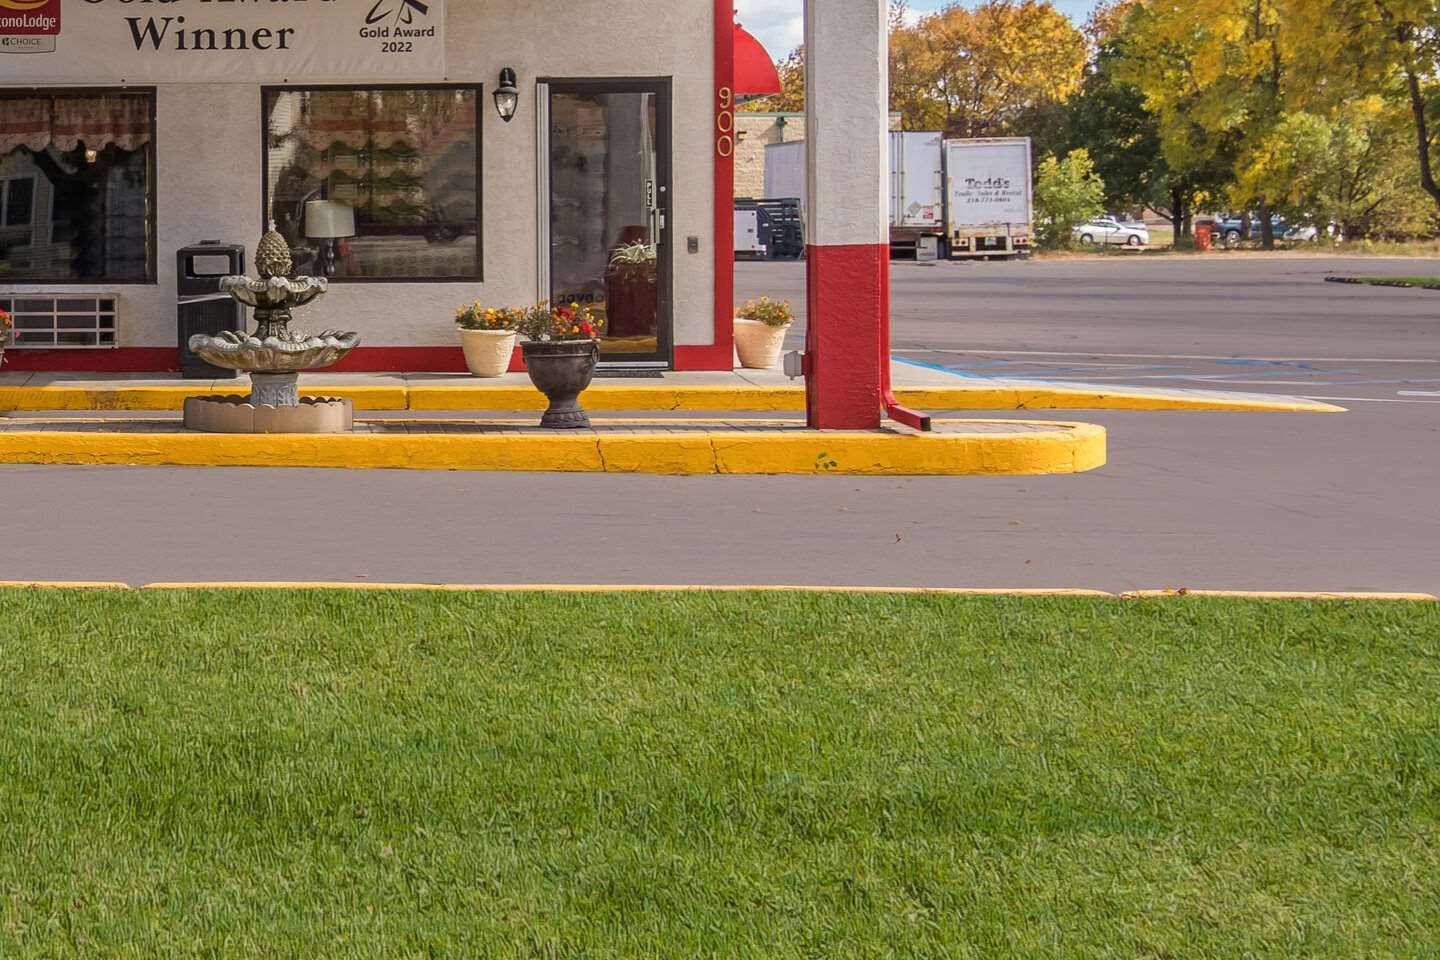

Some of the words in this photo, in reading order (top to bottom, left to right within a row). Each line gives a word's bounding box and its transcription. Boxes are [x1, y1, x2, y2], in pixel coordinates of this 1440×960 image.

[124, 15, 296, 51] Winner
[359, 26, 390, 38] Gold
[393, 25, 436, 38] Award
[381, 41, 413, 53] 2022
[717, 87, 733, 157] 900
